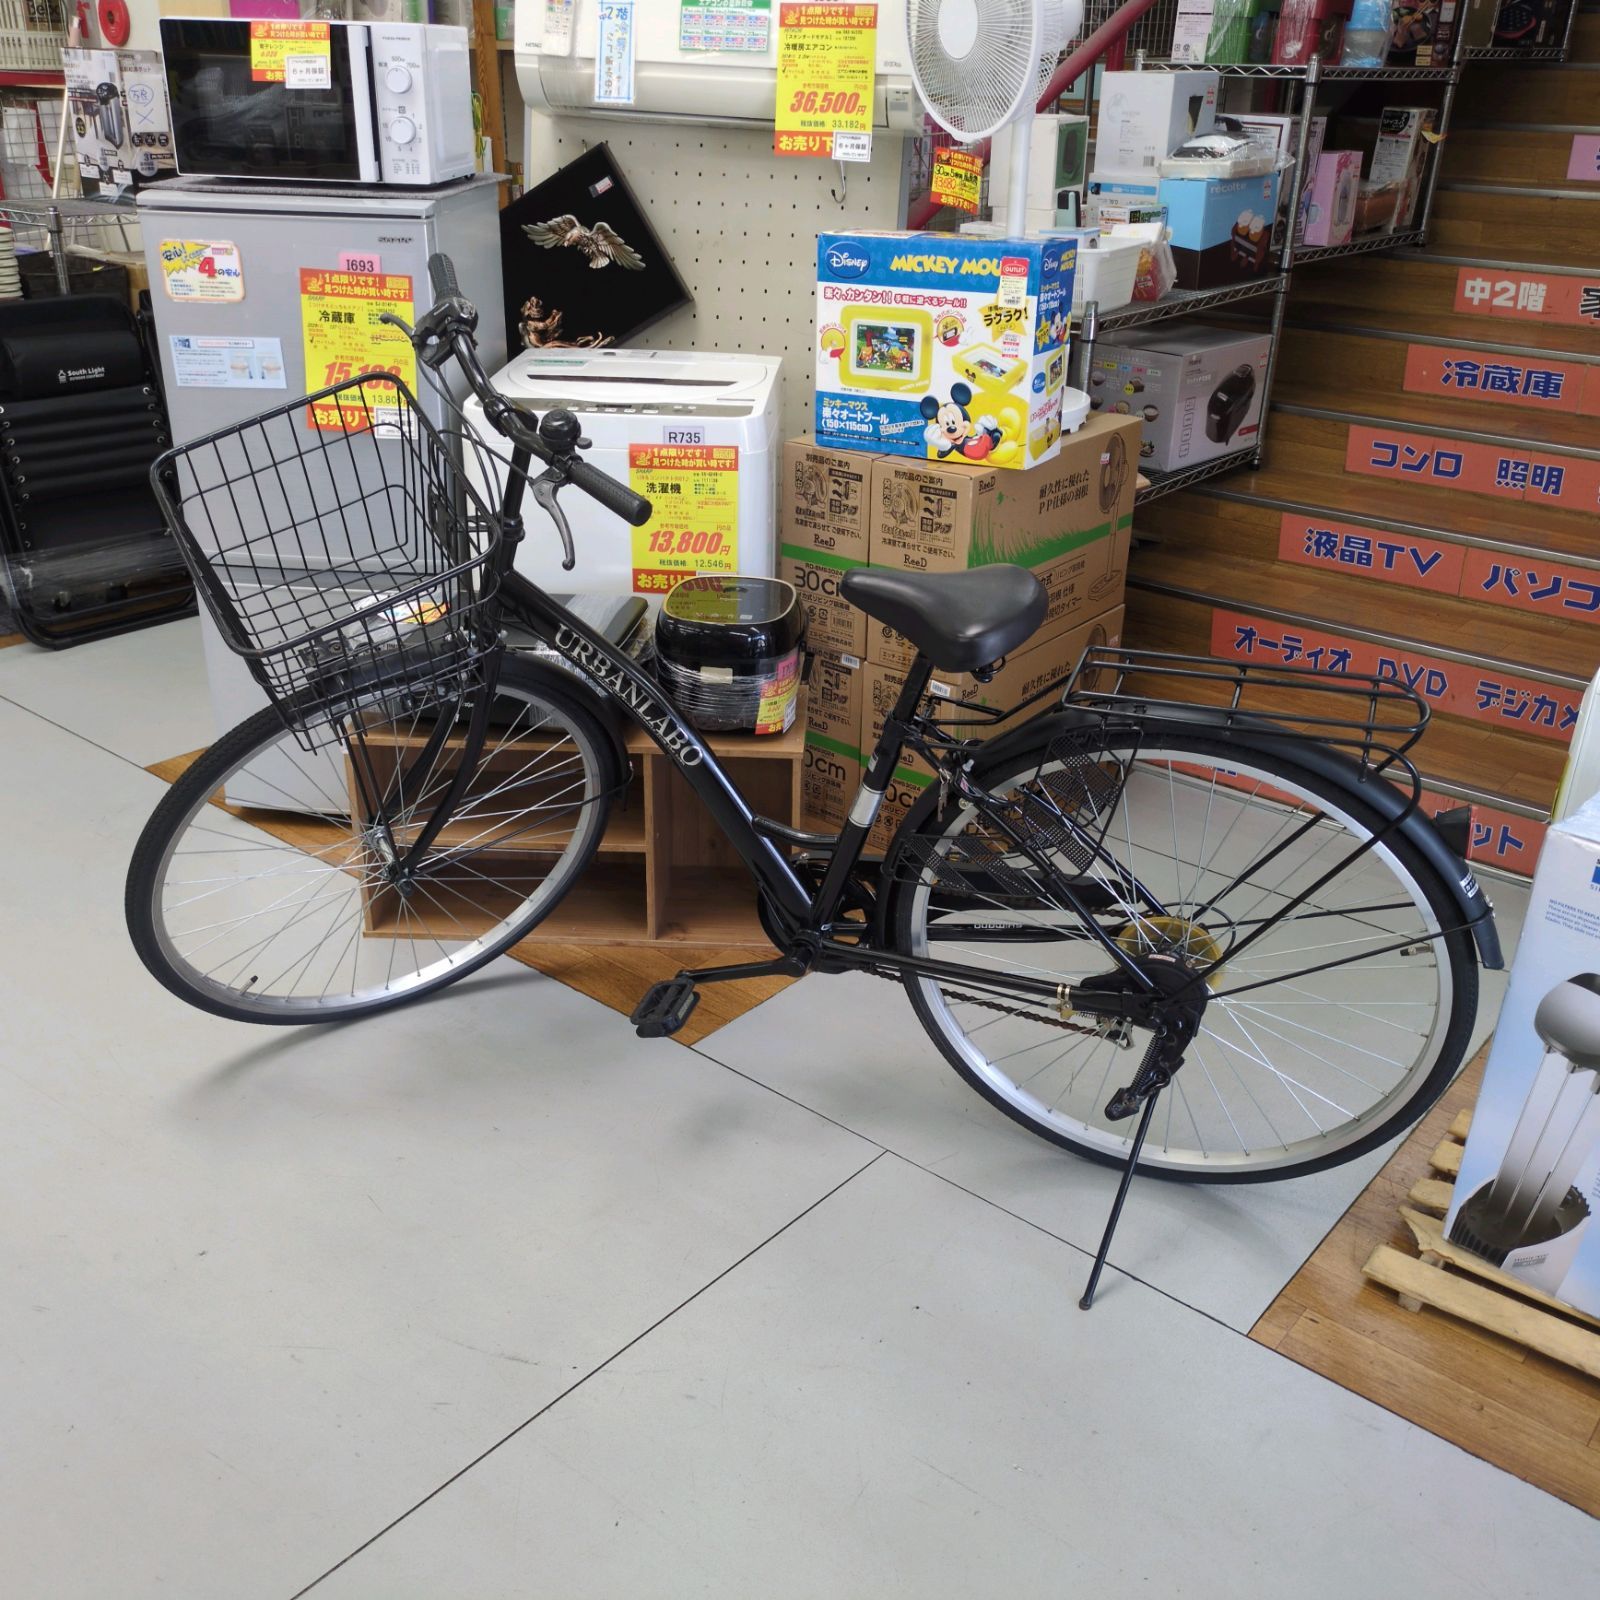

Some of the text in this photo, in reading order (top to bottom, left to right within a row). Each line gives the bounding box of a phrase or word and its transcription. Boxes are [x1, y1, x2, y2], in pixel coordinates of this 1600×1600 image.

[783, 42, 833, 51] 冷暖房エアコン
[827, 250, 868, 272] Disney
[890, 253, 1001, 278] MICKEY MOU
[324, 283, 410, 300] 見つけた時が買い時です!
[1464, 277, 1548, 313] 中2階
[318, 310, 356, 324] 冷蔵庫
[983, 306, 1029, 327] ラクラク!
[67, 366, 105, 377] South Light
[1441, 359, 1566, 400] 冷蔵庫
[823, 397, 869, 411] ミッキーマウス
[822, 406, 890, 425] 楽々オートプール
[668, 431, 701, 444] R735
[653, 458, 736, 469] 見つけた時が買い時です!
[806, 453, 851, 470] 別売品のご案内
[1370, 440, 1565, 497] コンロ 照明
[894, 469, 944, 487] 別売品のご案内
[978, 475, 996, 492] ReeD
[646, 482, 682, 494] 洗濯機
[814, 534, 836, 549] ReeD
[1303, 526, 1442, 577] 液晶TV
[903, 553, 928, 568] ReeD
[800, 591, 851, 612] カ式リビング扇風機
[554, 623, 703, 767] URBANLABO
[961, 684, 979, 700] ReeD
[1376, 658, 1449, 698] DVD
[1475, 678, 1583, 730] デジカメ
